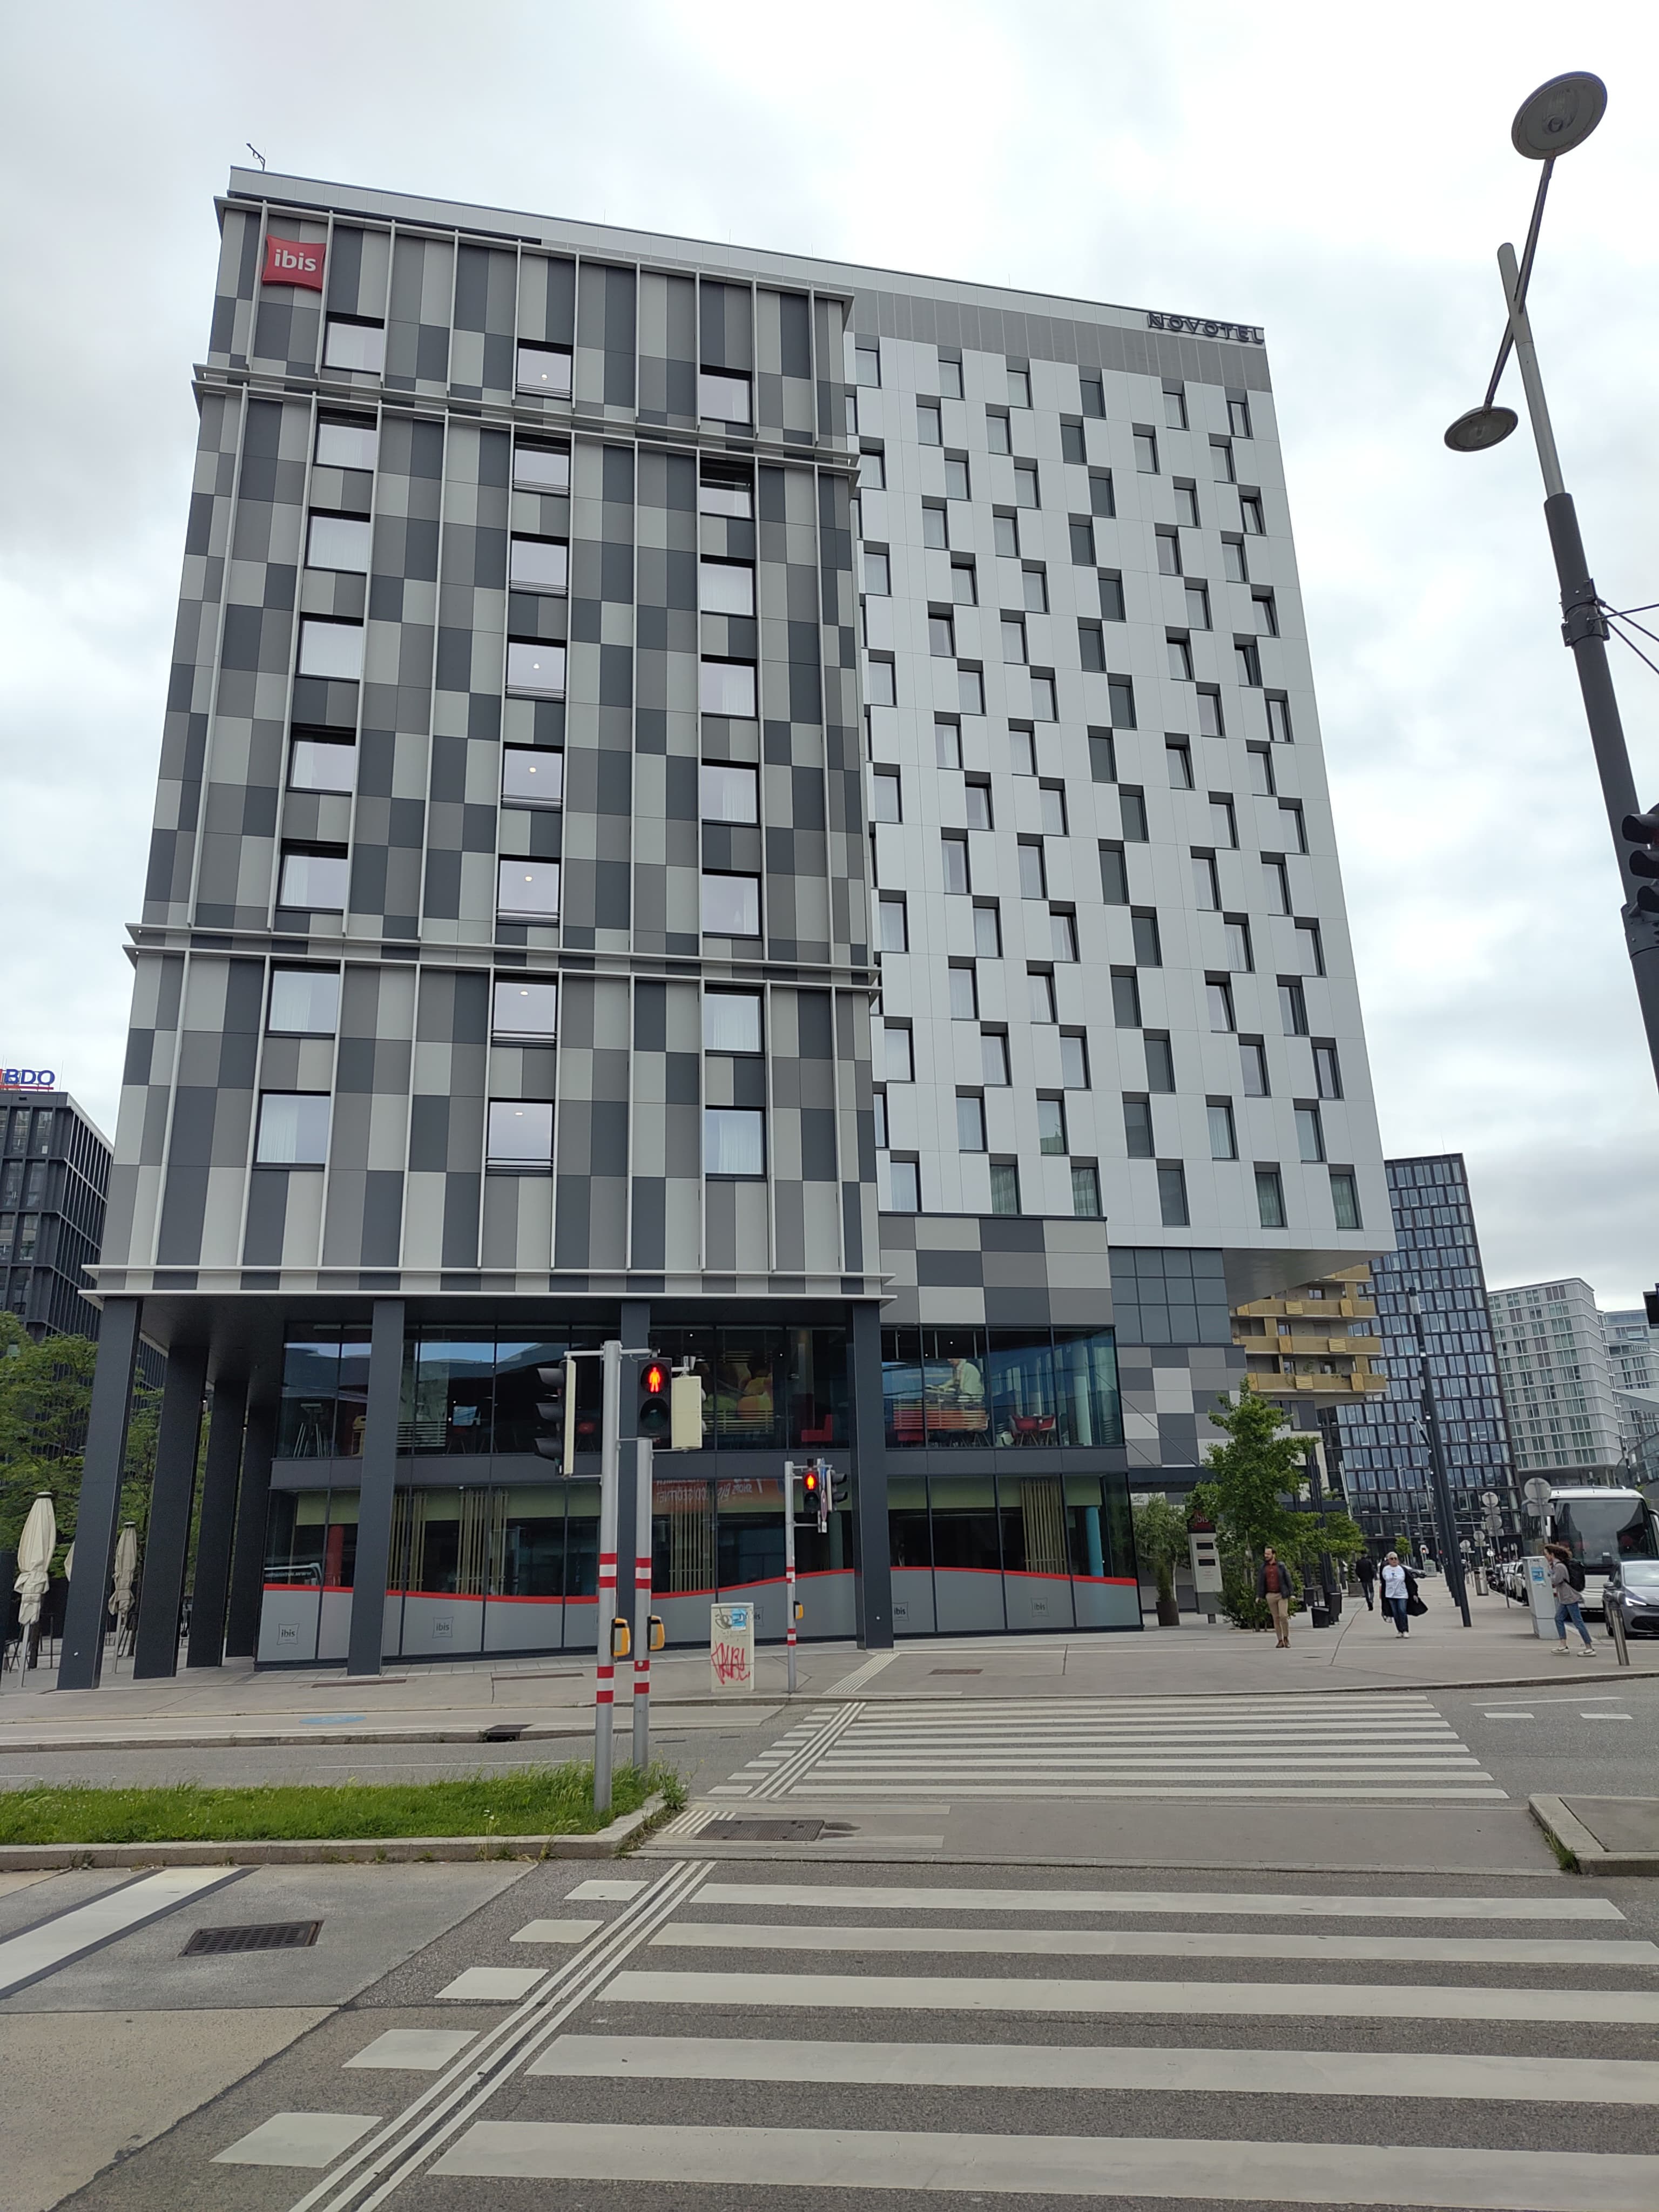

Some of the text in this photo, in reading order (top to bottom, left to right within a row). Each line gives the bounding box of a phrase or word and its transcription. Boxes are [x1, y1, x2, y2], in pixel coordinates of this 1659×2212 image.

[274, 248, 316, 272] ibis
[1147, 312, 1264, 344] NOVOTEL
[5, 1069, 55, 1085] BDO
[281, 1629, 295, 1637] ibis
[436, 1623, 450, 1631] ibis
